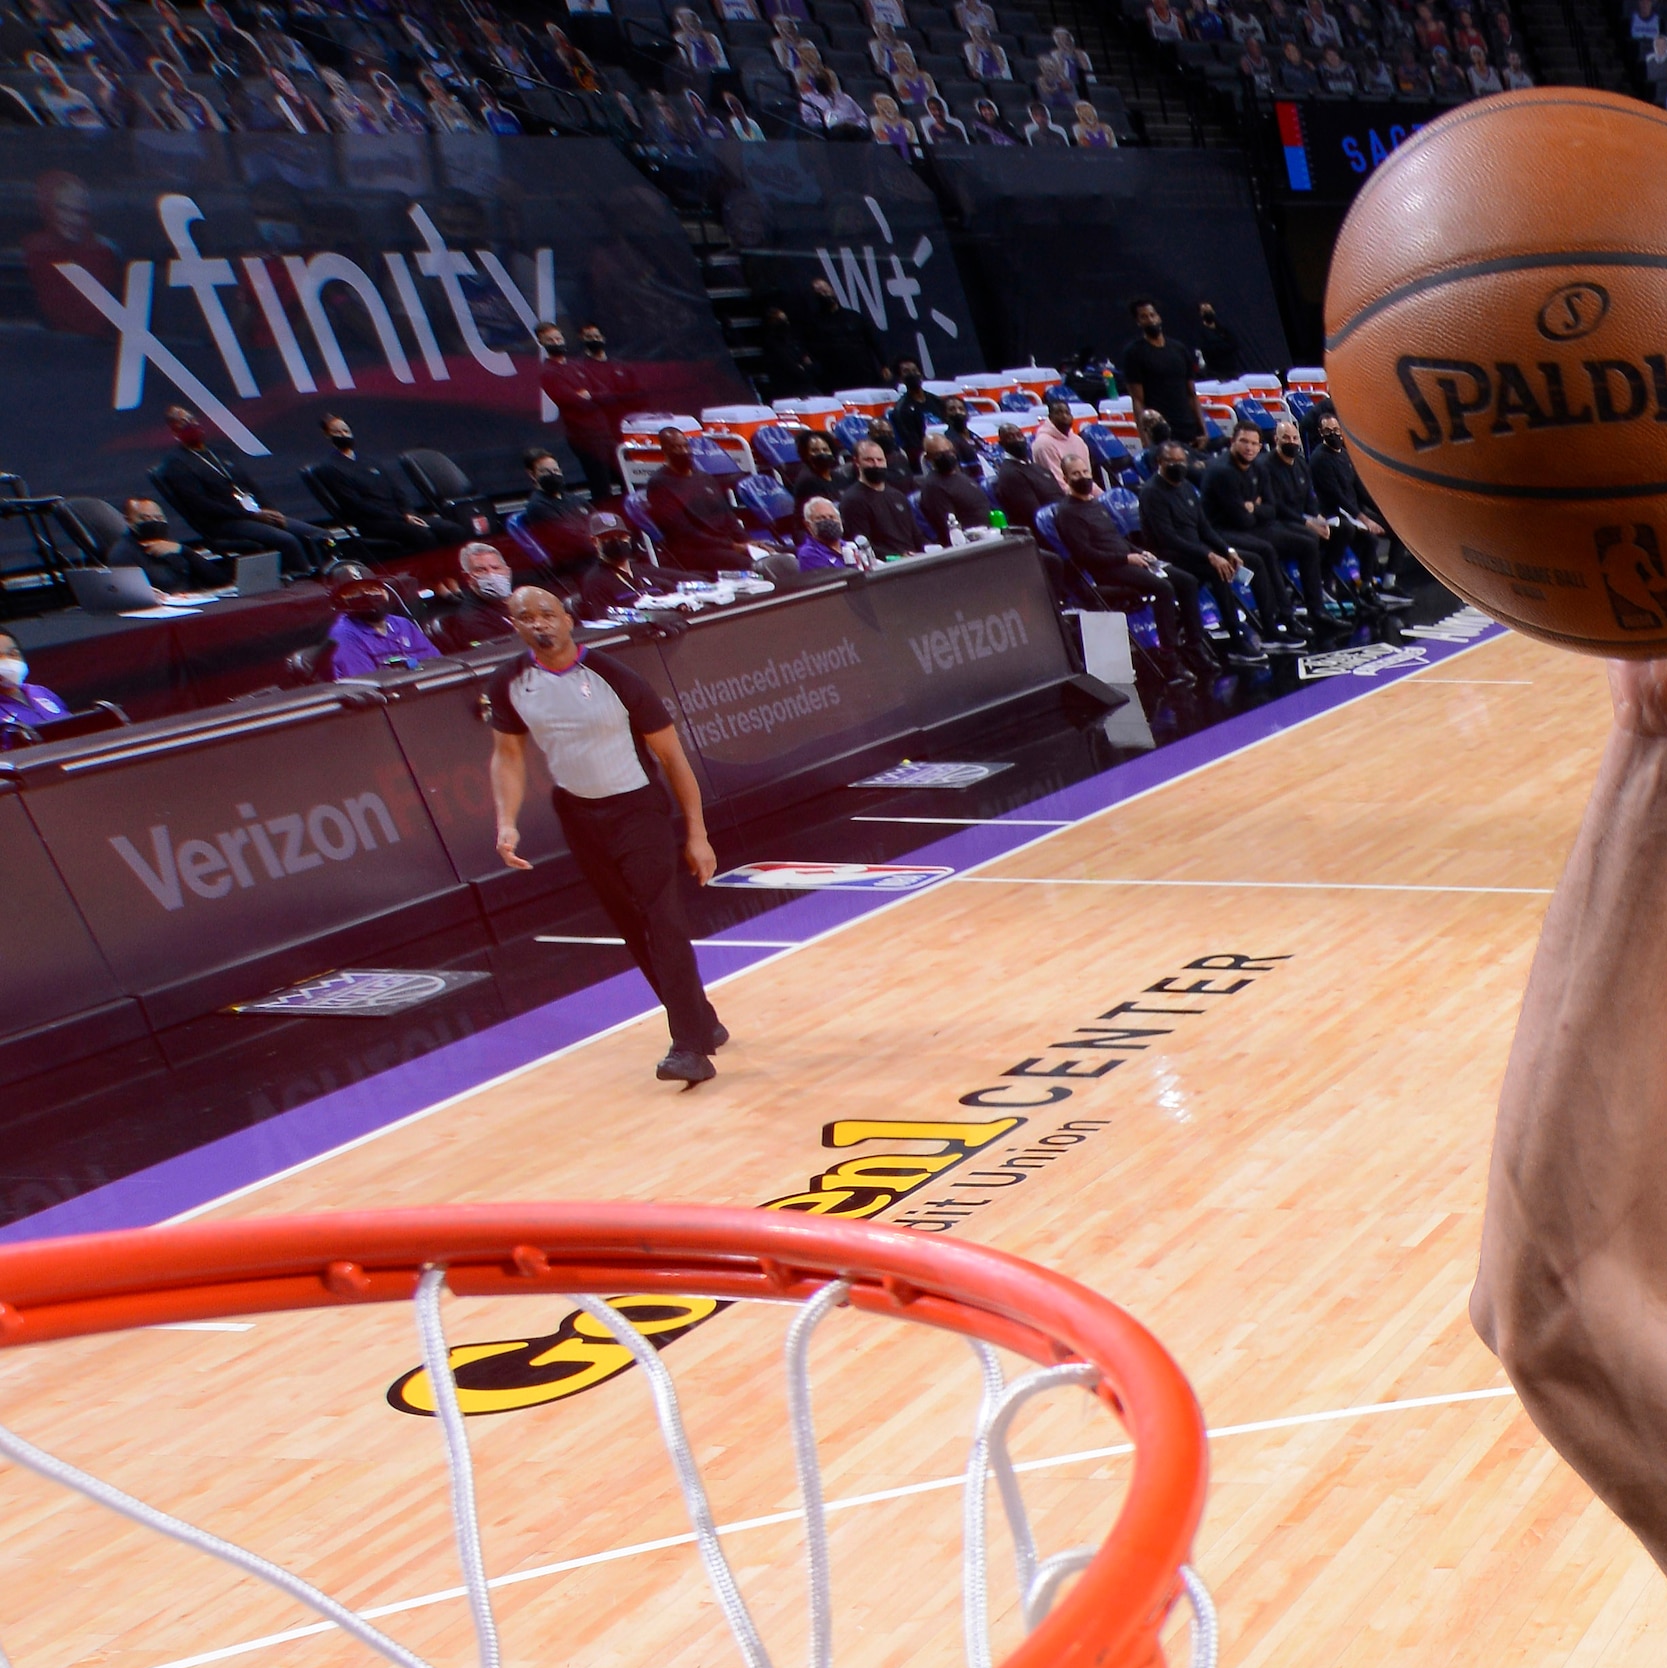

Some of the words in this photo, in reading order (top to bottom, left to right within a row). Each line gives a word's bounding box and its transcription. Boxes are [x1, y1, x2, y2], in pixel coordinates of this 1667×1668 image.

[55, 193, 556, 456] xfinity
[680, 660, 781, 713] advanced
[781, 636, 862, 687] network
[908, 606, 1030, 676] verizon
[730, 682, 841, 738] responders
[110, 790, 401, 912] Verizon
[958, 952, 1295, 1110] CENTER
[950, 1119, 1112, 1189] Union
